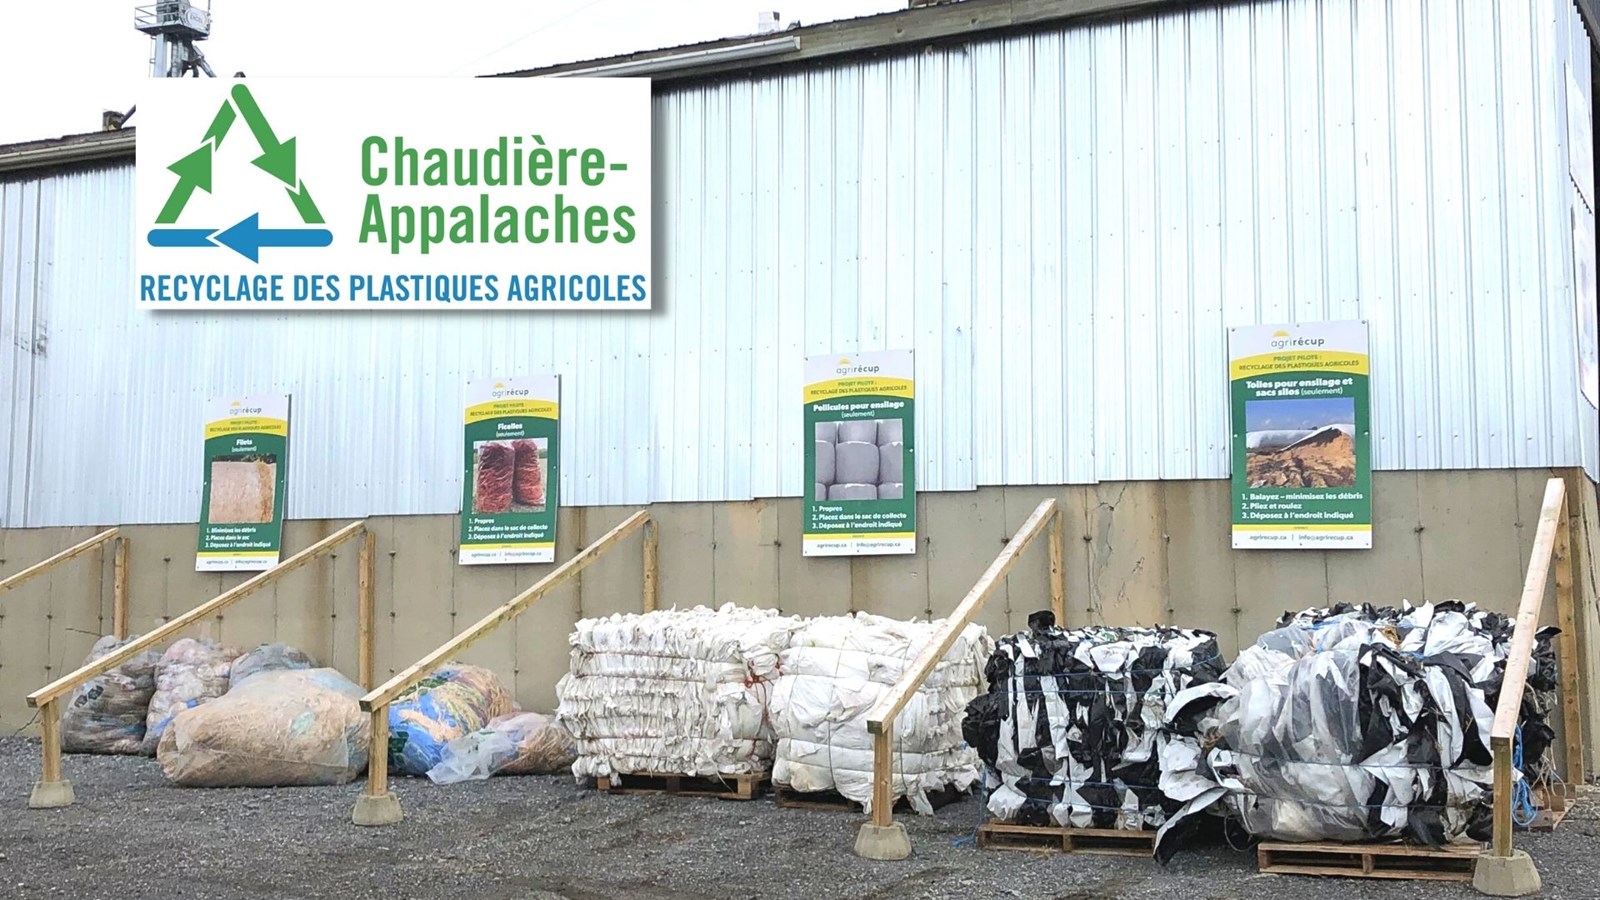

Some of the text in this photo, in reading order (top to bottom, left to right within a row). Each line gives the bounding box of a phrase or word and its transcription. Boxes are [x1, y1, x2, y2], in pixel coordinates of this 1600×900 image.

[1271, 337, 1324, 349] agrirécup
[836, 365, 880, 375] agrirécup
[1275, 381, 1298, 389] pour
[1299, 378, 1340, 388] ensilage
[1278, 388, 1300, 396] silos
[1301, 387, 1343, 396] (seulement)
[813, 401, 904, 411] Pellicules pour ensilage
[842, 410, 875, 418] (seulement)
[1250, 493, 1279, 501] Balayez
[1338, 492, 1363, 500] débris
[1250, 512, 1282, 520] Déposez
[1324, 512, 1354, 520] indiqué
